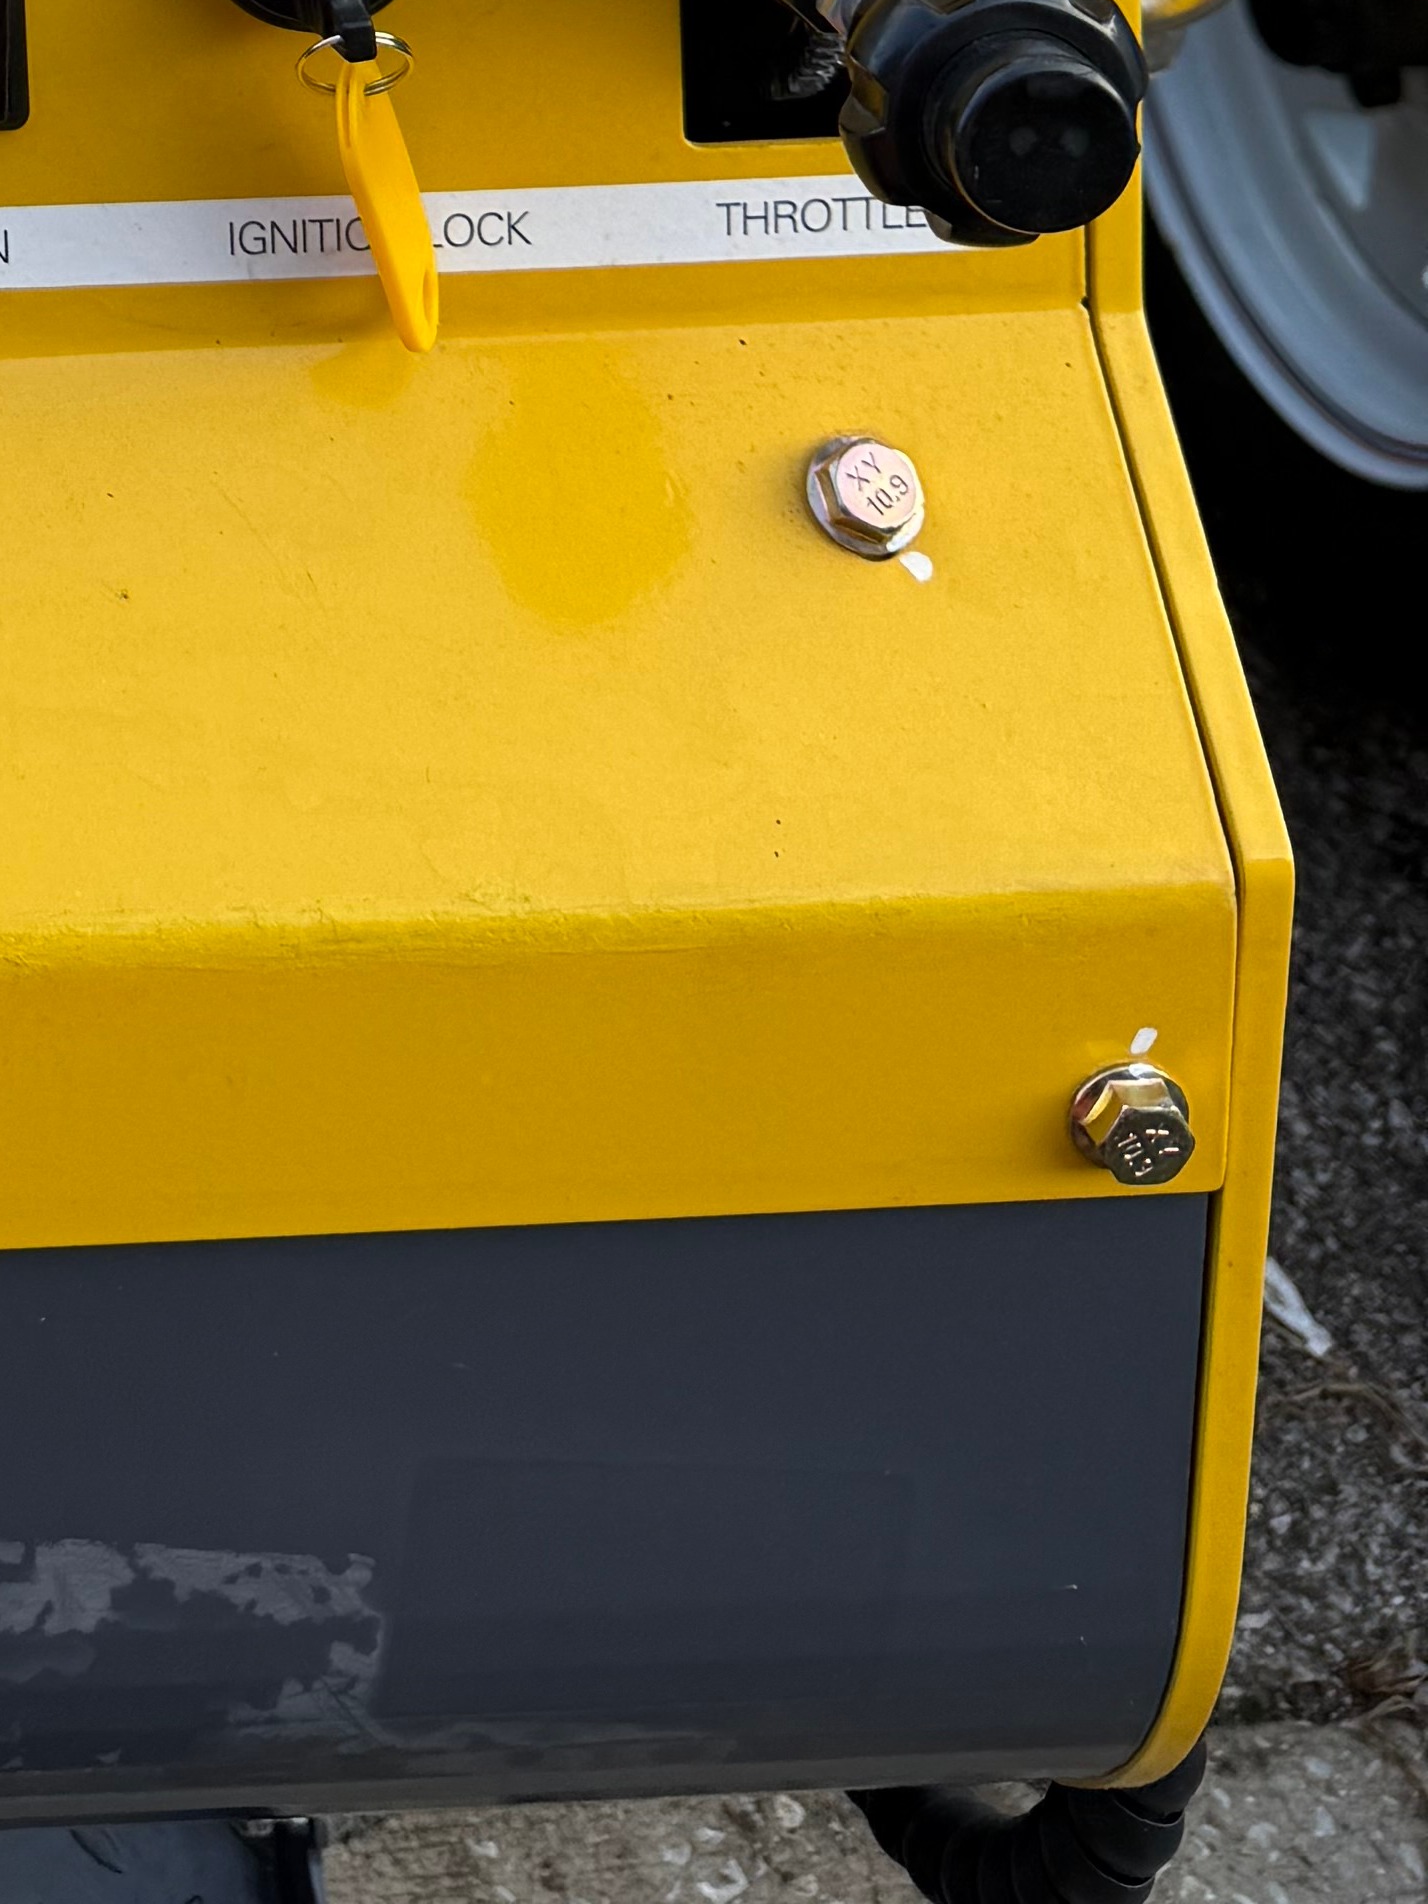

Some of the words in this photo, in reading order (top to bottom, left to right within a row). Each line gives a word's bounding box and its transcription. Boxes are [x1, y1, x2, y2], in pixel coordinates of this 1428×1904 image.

[229, 216, 373, 256] IGNITIO
[432, 210, 534, 249] OCK
[715, 195, 928, 237] THROTTLE
[844, 451, 882, 492] XY
[866, 473, 910, 517] 10.9
